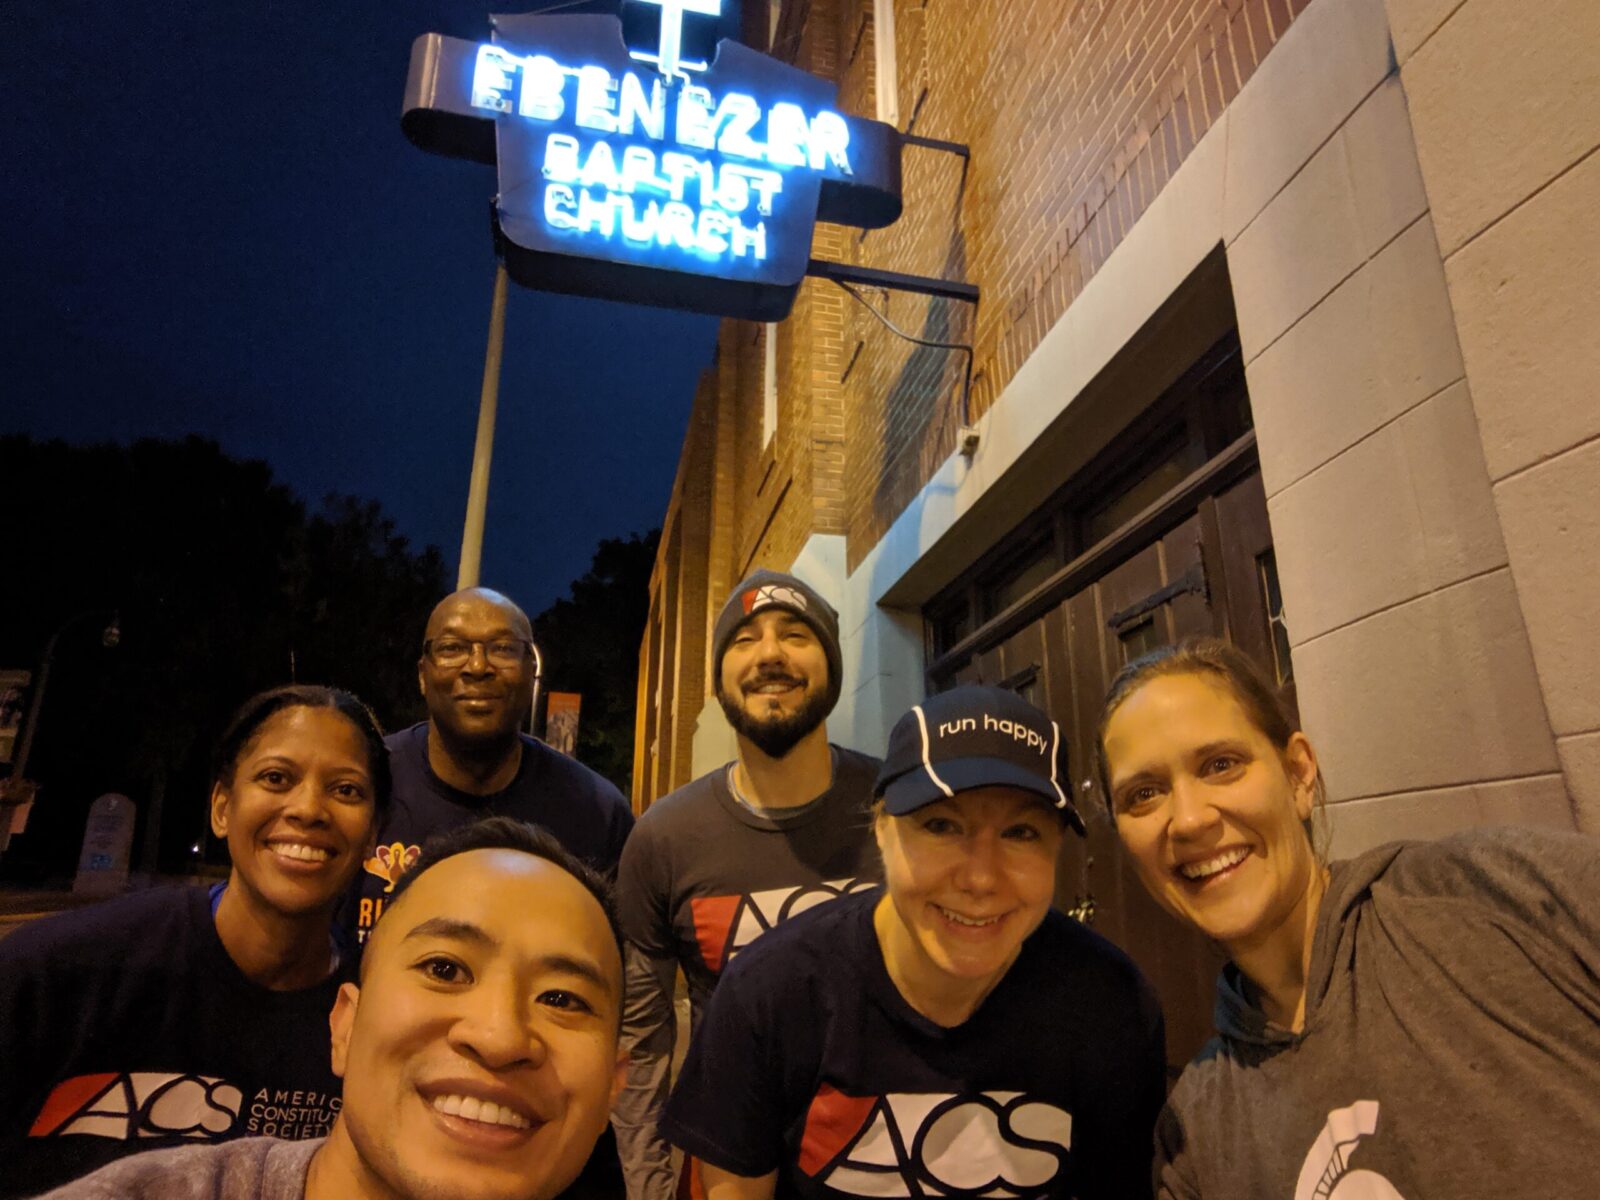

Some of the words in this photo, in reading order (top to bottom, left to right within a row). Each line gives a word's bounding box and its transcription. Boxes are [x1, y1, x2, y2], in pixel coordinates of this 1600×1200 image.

[471, 44, 853, 174] EBENEZER
[543, 133, 783, 216] BAPTIST
[544, 184, 767, 259] CHURCH
[940, 718, 976, 738] run
[984, 714, 1048, 755] happy
[30, 1071, 243, 1140] ACS
[254, 1088, 342, 1111] AMERIC
[798, 1082, 1073, 1199] ACS
